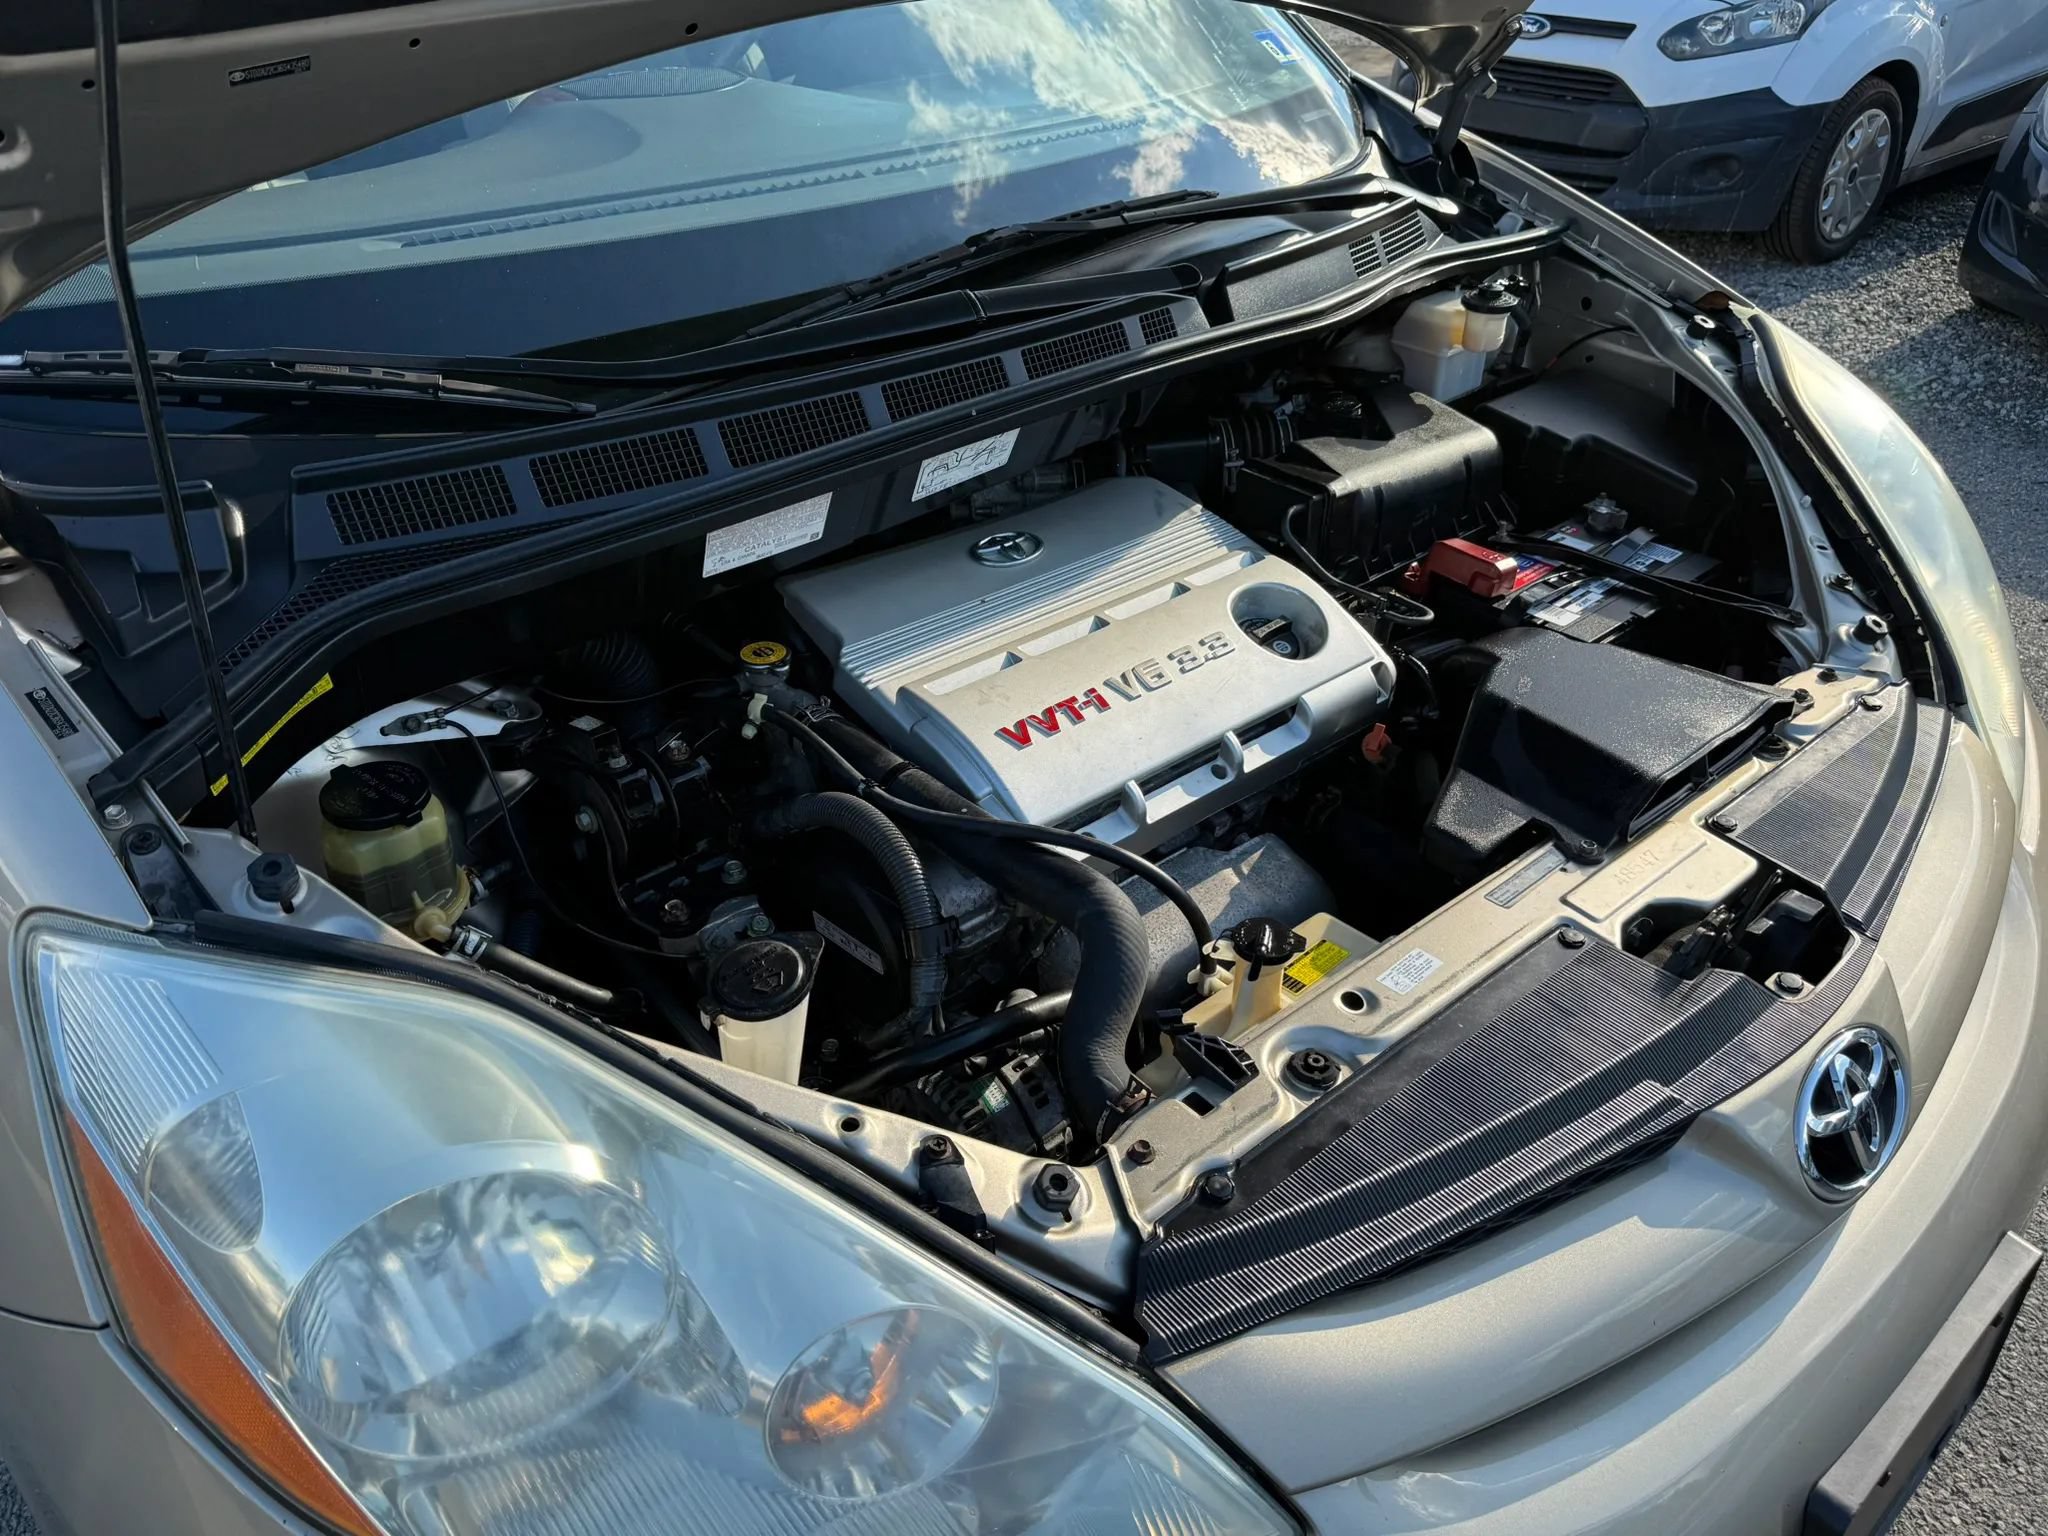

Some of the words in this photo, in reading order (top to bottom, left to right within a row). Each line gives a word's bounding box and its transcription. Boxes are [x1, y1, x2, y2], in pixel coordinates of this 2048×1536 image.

[744, 534, 788, 553] CATALYST
[1102, 657, 1173, 702] V6
[1167, 631, 1236, 675] 3.3
